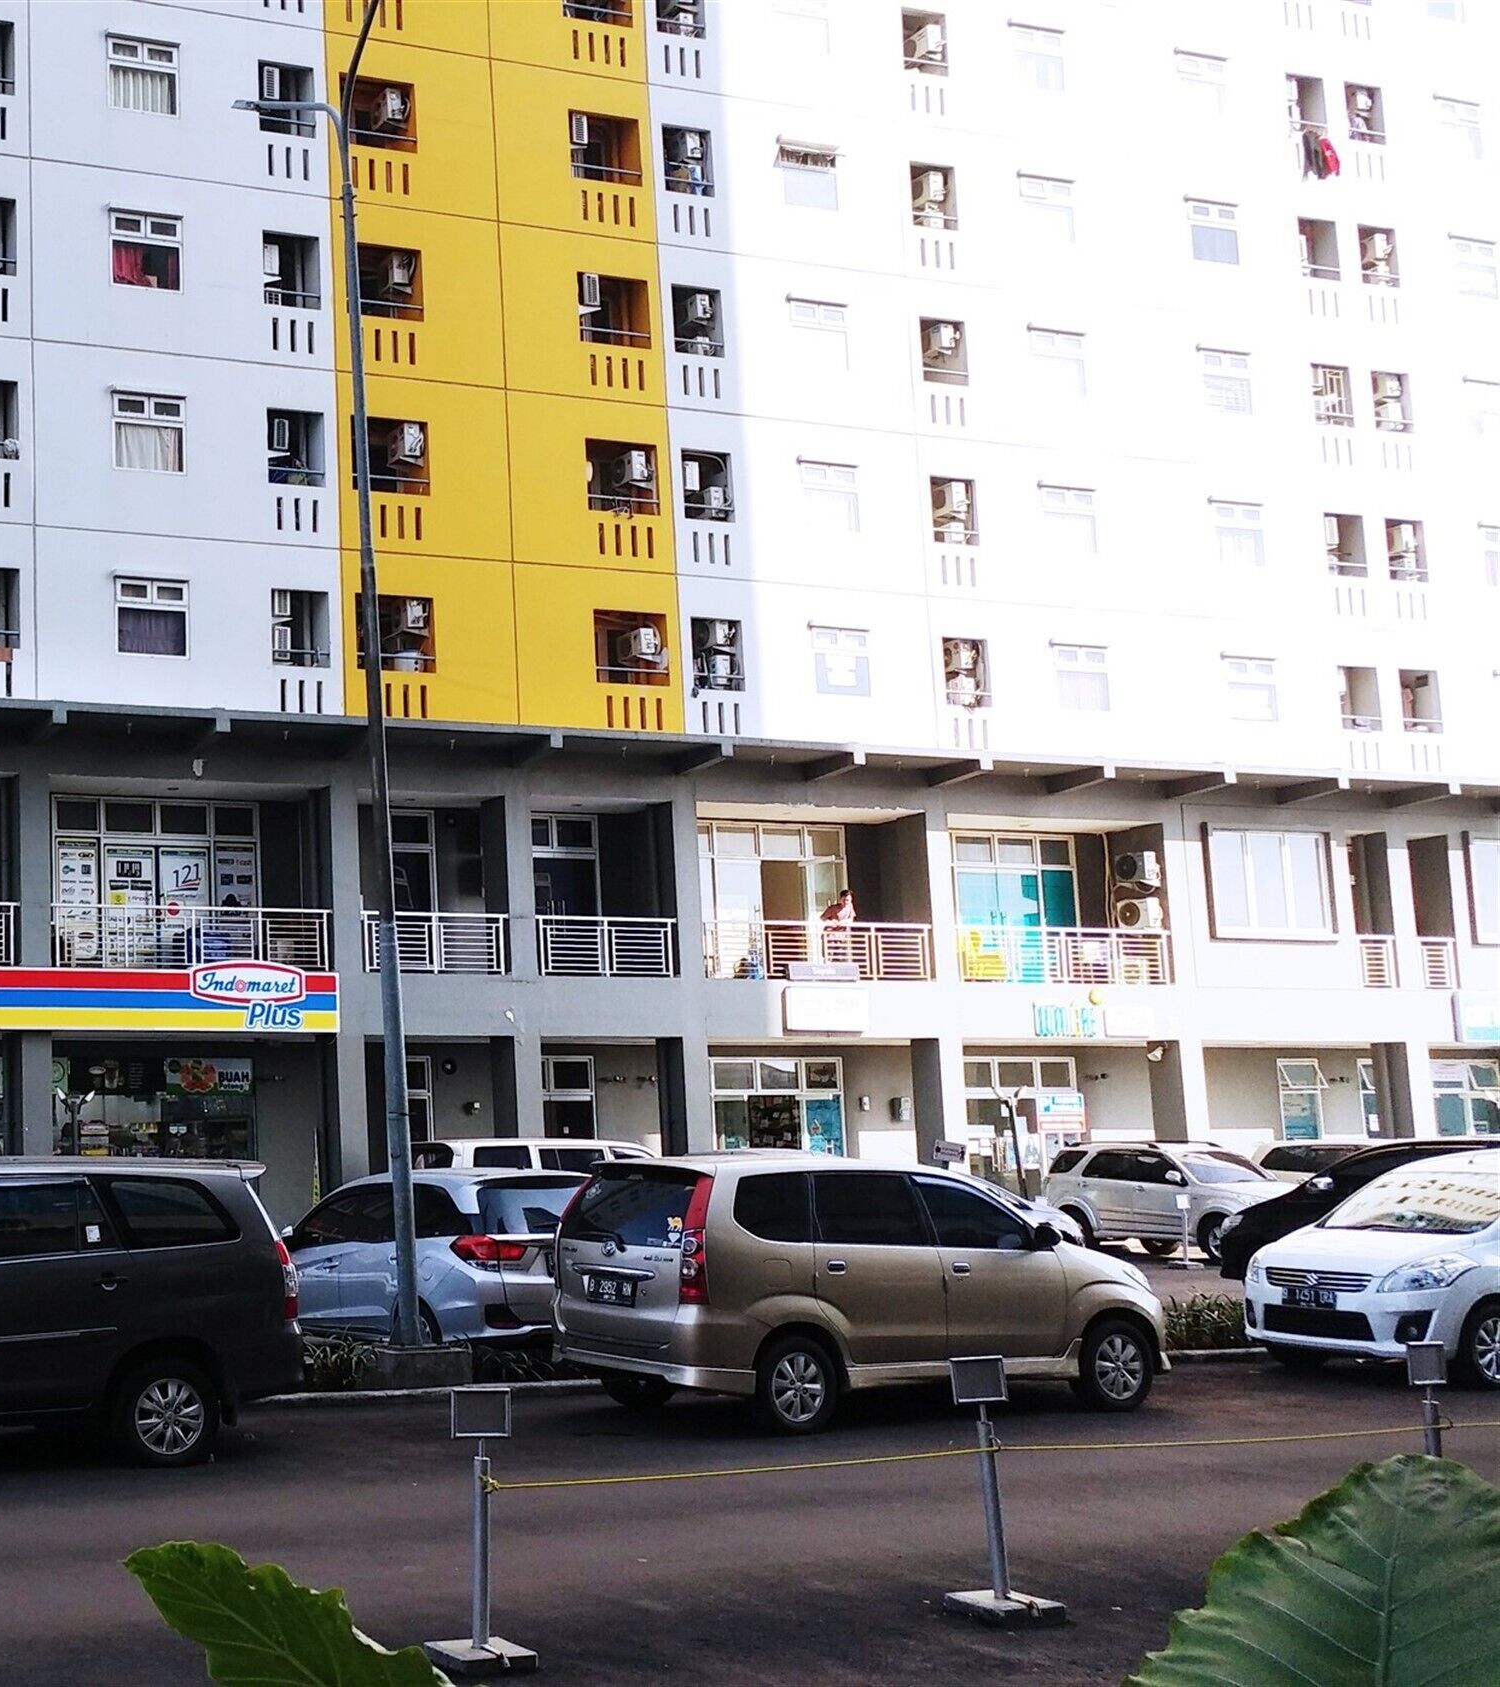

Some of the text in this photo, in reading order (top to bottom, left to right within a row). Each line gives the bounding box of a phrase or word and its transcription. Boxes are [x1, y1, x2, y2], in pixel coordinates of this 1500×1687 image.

[172, 863, 201, 888] 121
[198, 971, 297, 994] Indomaret
[249, 1002, 301, 1027] Plus
[217, 1071, 250, 1084] BUAH
